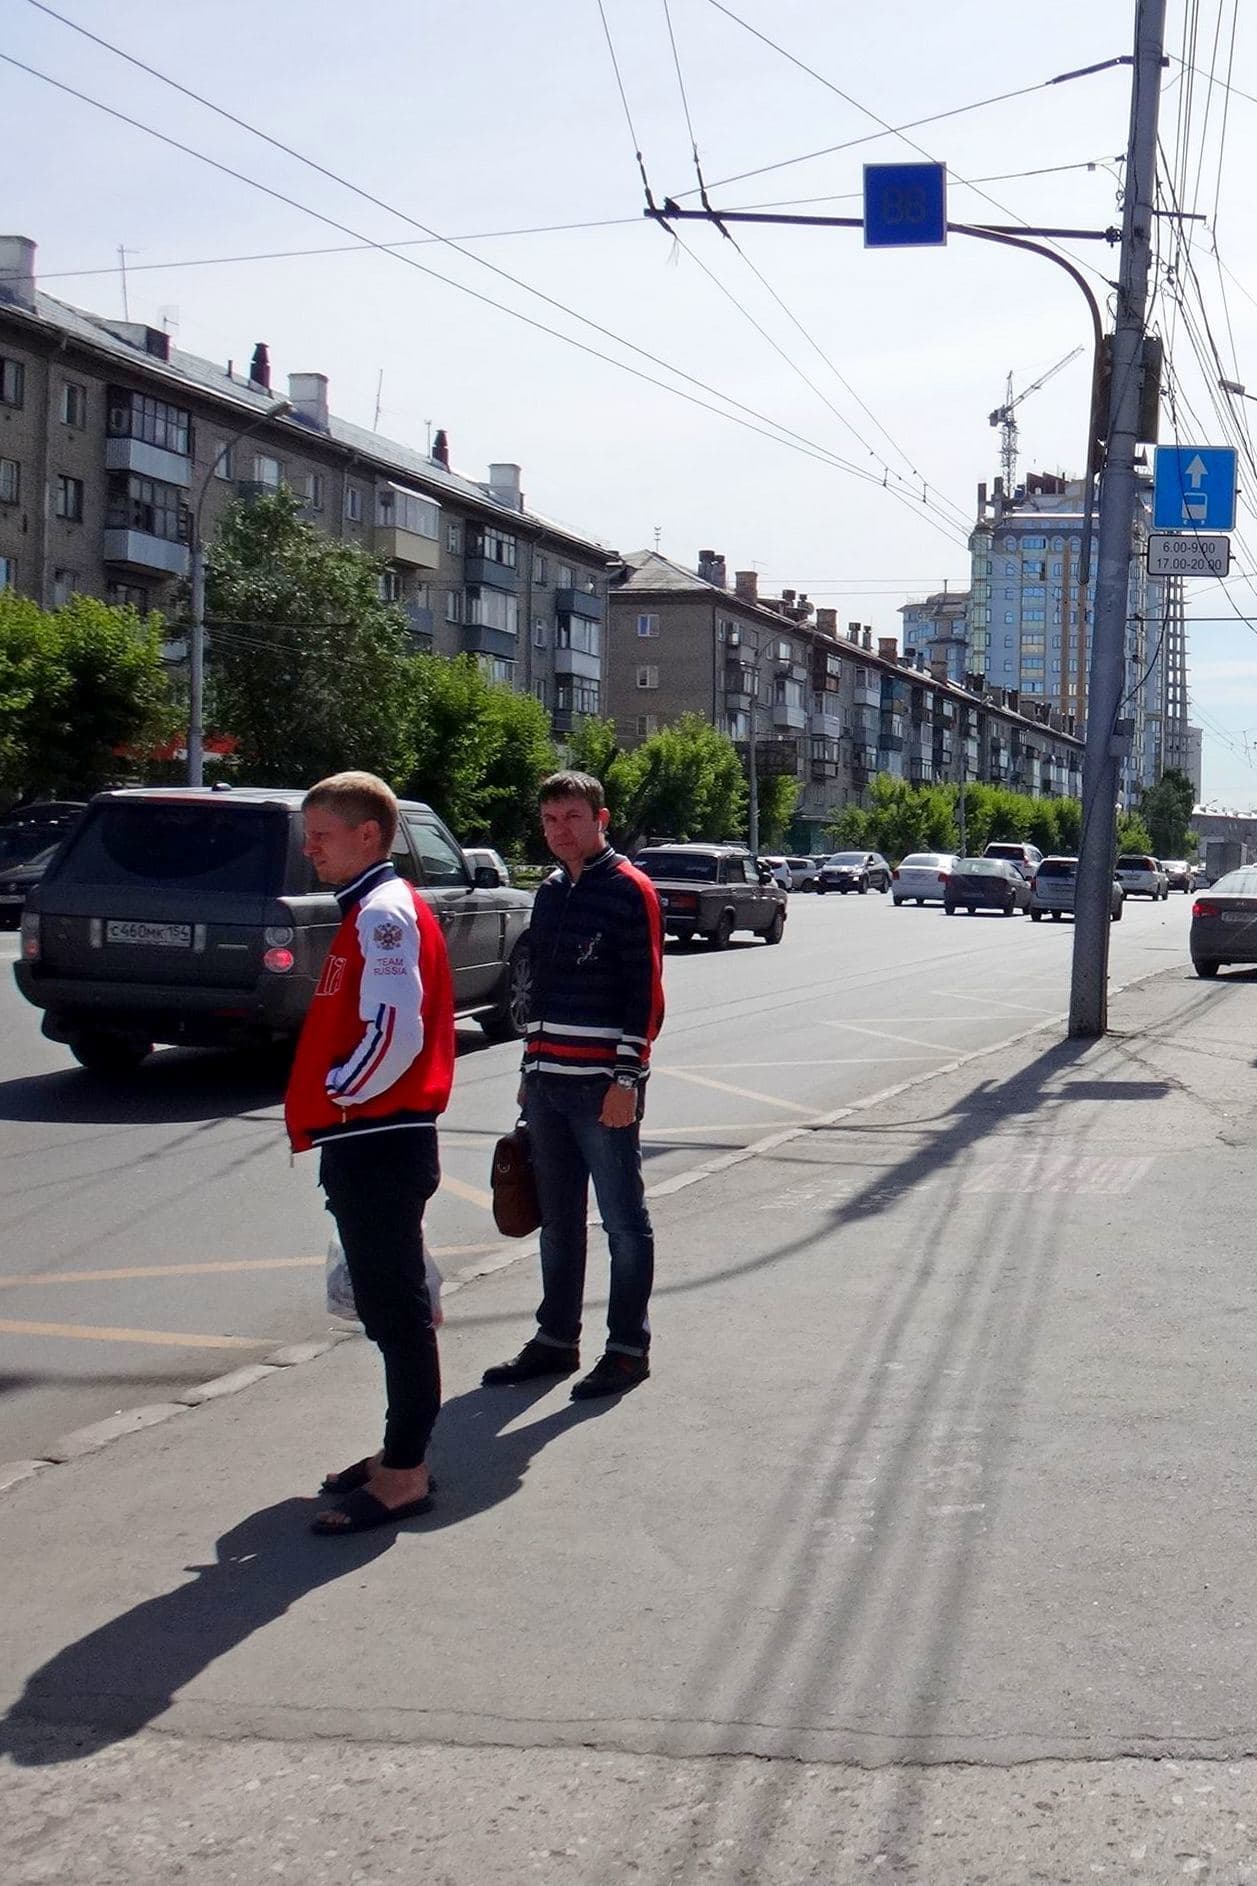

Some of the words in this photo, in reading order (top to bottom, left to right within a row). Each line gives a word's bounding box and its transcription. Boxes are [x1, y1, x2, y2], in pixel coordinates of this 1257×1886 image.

[1157, 558, 1222, 570] 17.00-20.00
[377, 958, 404, 966] TEAM
[373, 967, 408, 976] RUSSIA
